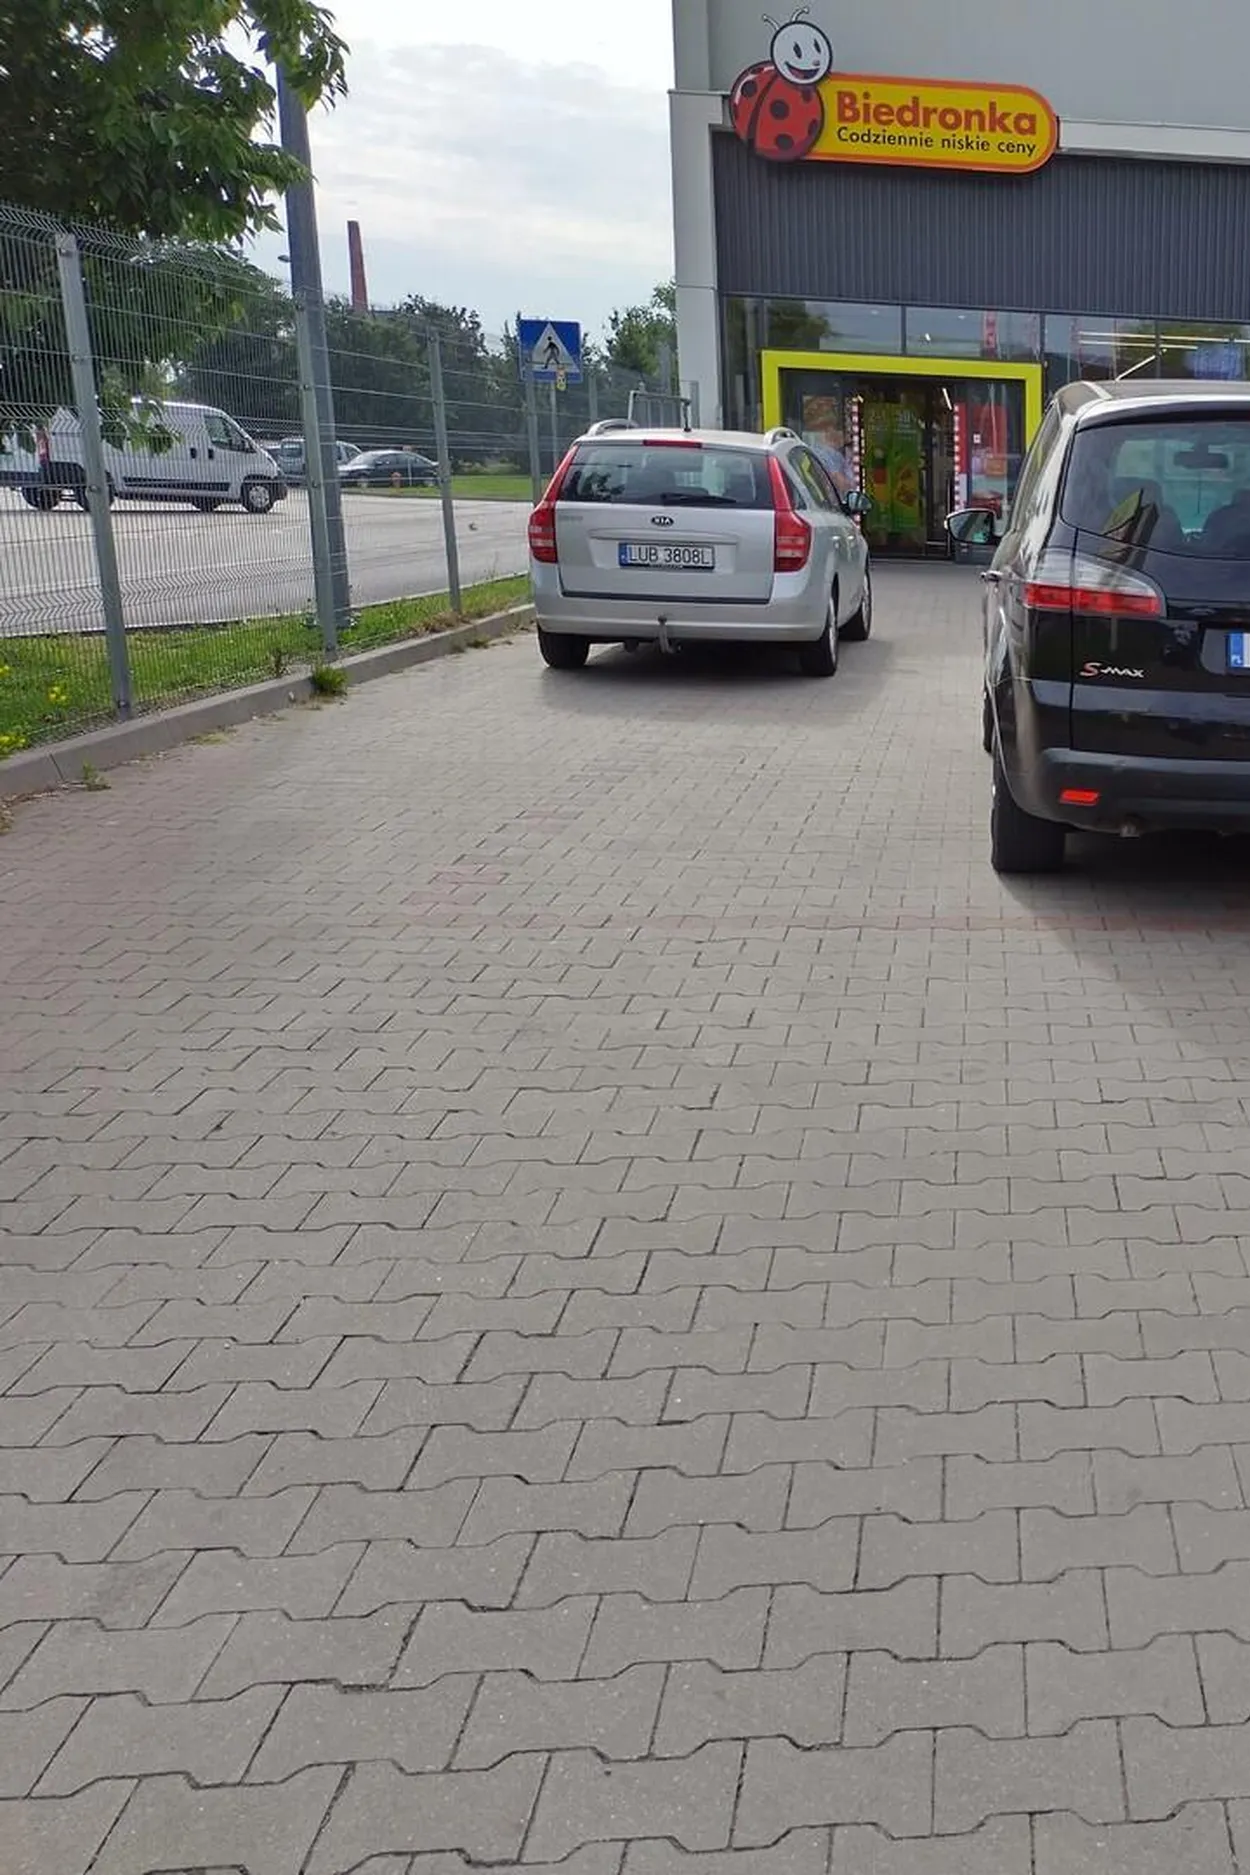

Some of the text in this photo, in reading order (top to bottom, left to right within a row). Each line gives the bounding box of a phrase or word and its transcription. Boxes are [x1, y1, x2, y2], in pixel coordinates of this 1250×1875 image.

[837, 91, 1037, 135] Biedronka
[837, 126, 1036, 157] Codziennie niskie ceny
[654, 516, 671, 526] KIA
[628, 546, 659, 563] LUB
[664, 547, 710, 565] 3808L
